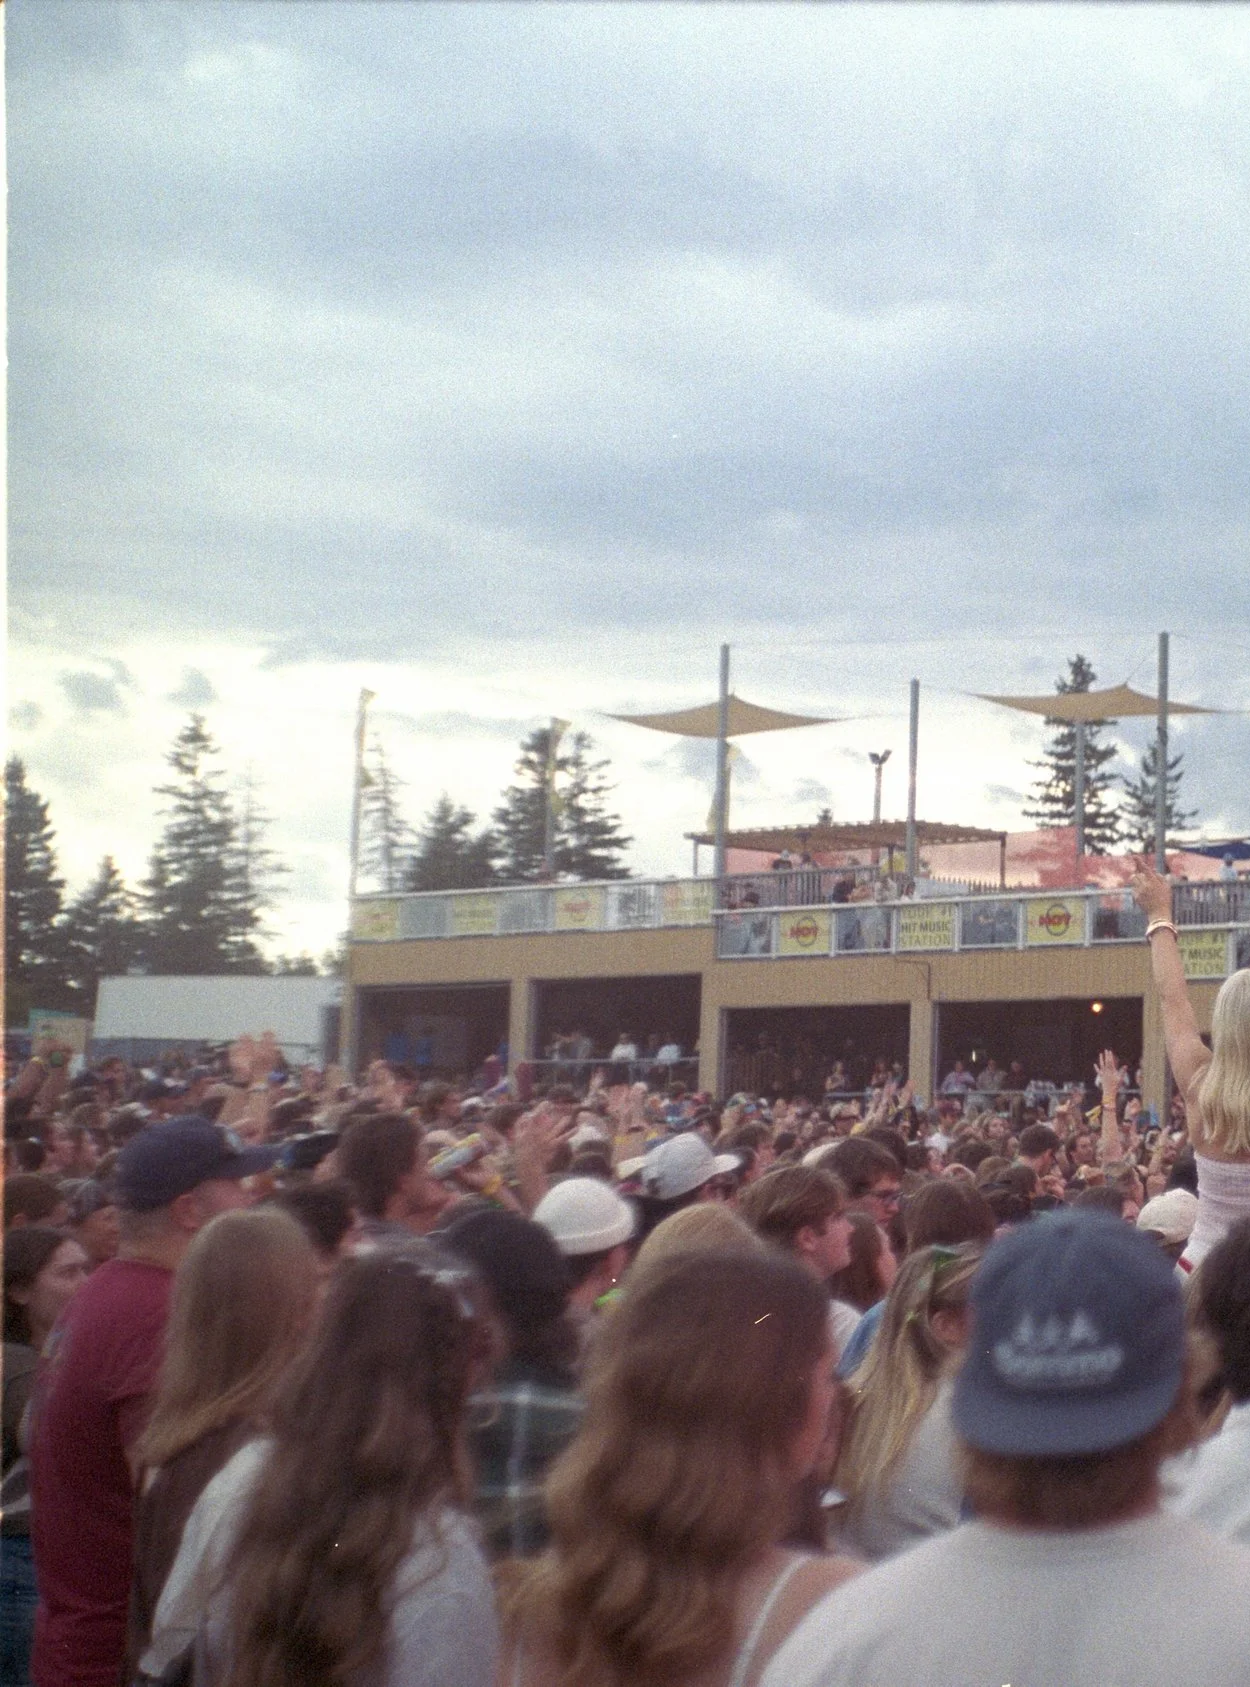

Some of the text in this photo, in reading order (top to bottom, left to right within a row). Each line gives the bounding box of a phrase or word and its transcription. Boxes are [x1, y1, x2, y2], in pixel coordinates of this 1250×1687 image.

[901, 920, 951, 934] HIT MUSIC
[1188, 948, 1224, 960] MUSIC
[1184, 961, 1224, 975] ATION
